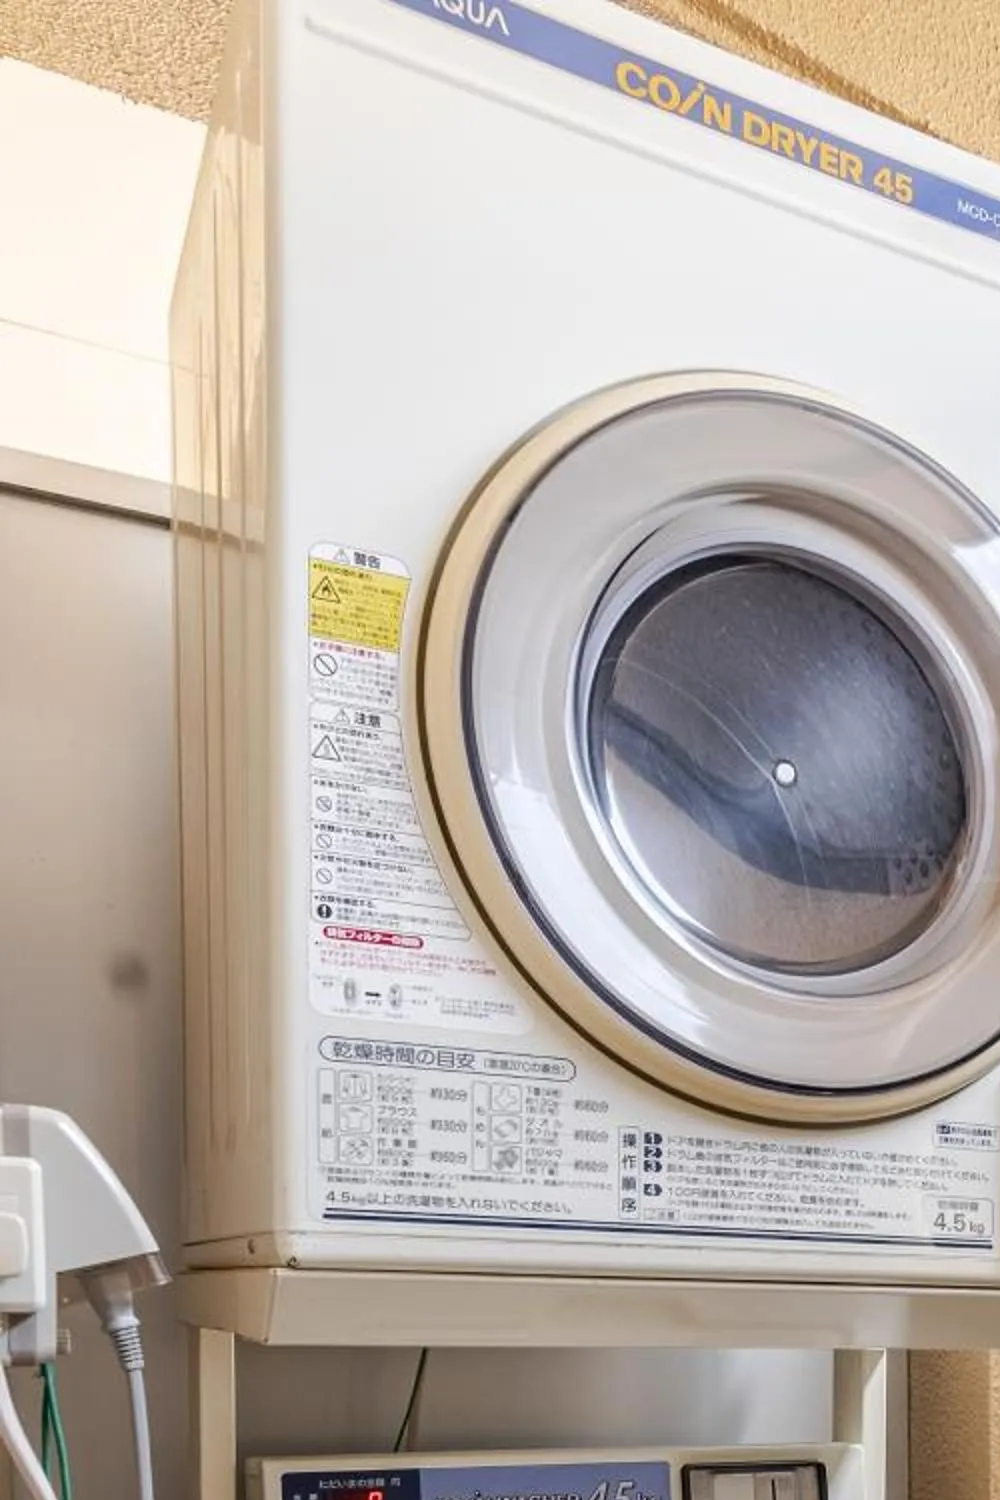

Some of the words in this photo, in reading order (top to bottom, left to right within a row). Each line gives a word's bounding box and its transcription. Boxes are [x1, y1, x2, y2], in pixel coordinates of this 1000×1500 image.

[615, 61, 732, 132] COIN
[743, 110, 864, 187] DRYER
[872, 166, 914, 204] 45
[354, 711, 382, 728] 注意
[333, 1041, 477, 1070] 乾燥時間の目安
[621, 1132, 637, 1213] 操作順序
